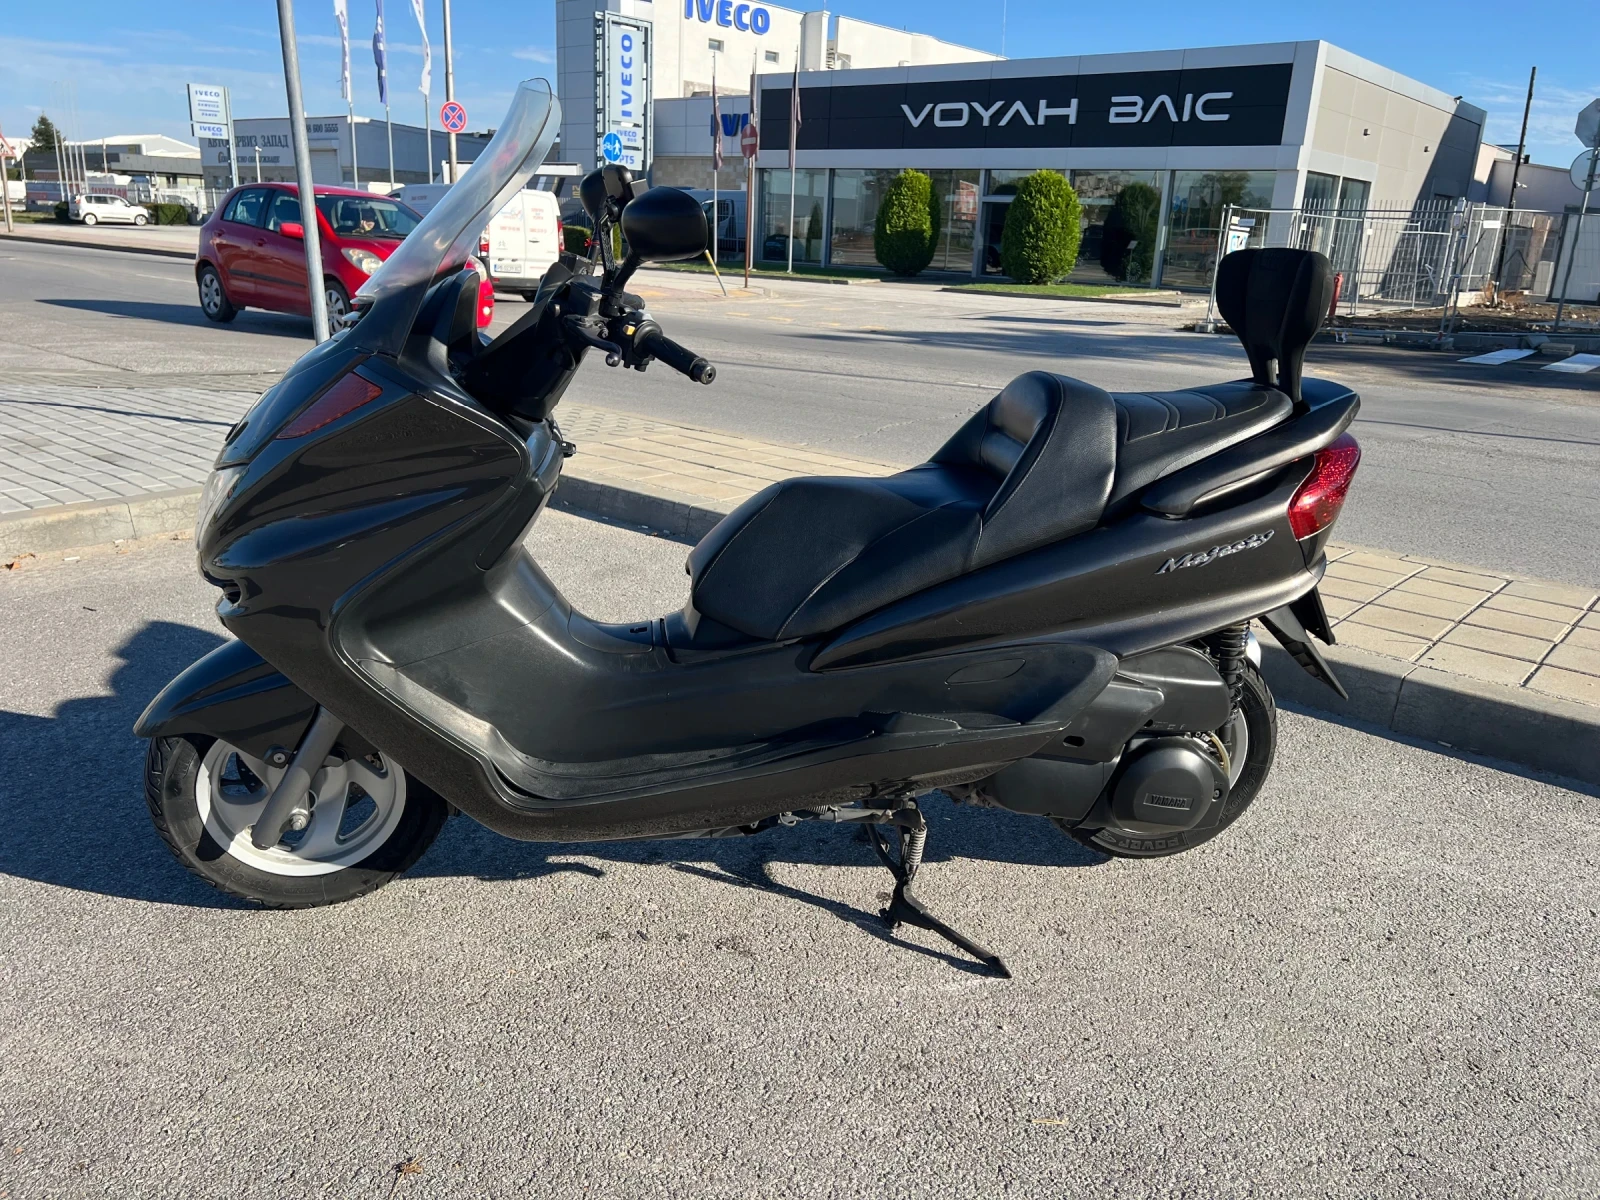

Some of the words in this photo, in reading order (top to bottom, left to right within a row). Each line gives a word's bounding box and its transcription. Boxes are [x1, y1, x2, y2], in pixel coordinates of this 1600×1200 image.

[685, 0, 771, 35] IVECO
[621, 34, 633, 118] IVECO
[194, 90, 220, 98] IVECO
[900, 97, 1080, 128] VOYAH
[1108, 91, 1235, 125] BAIC
[199, 125, 223, 133] IVECO
[616, 130, 637, 138] IVECO
[261, 134, 290, 149] ЗАПАД
[1153, 529, 1275, 575] Majesty
[1151, 794, 1188, 809] YAMAHA
